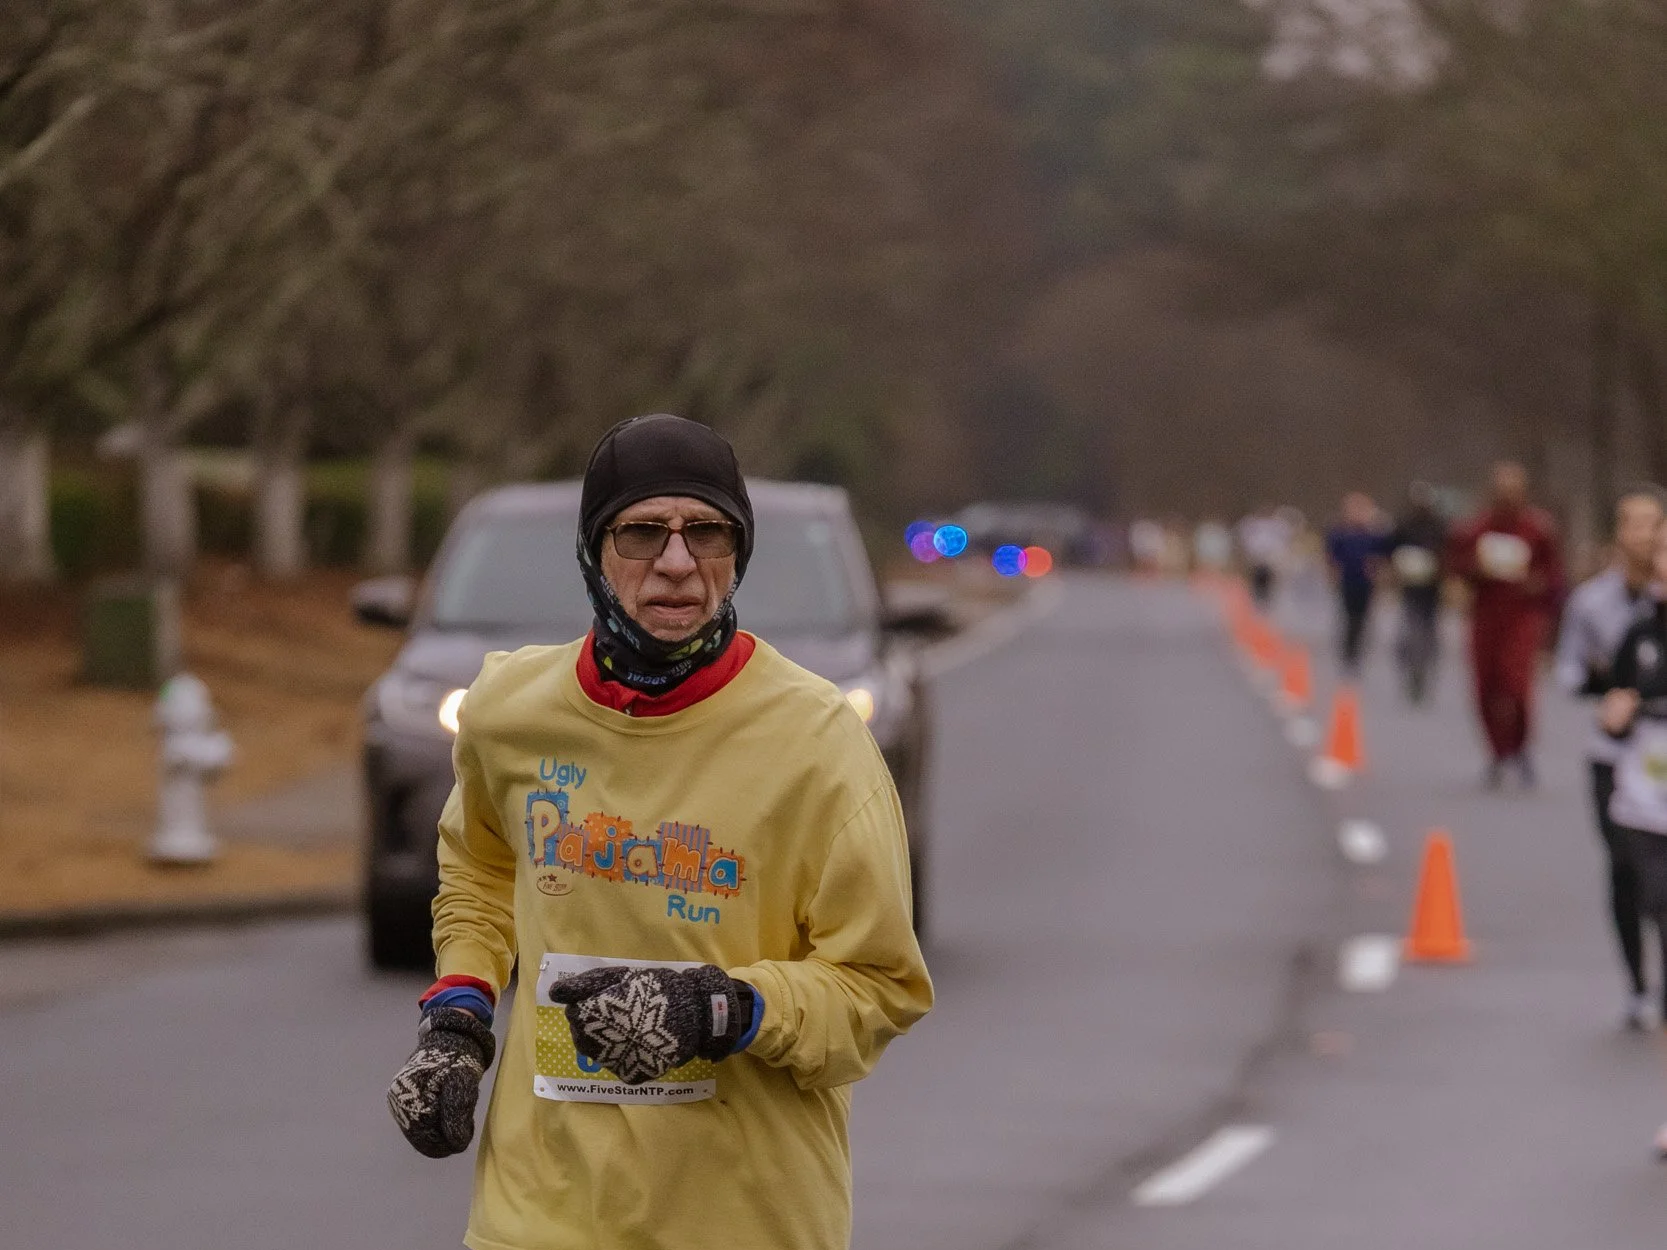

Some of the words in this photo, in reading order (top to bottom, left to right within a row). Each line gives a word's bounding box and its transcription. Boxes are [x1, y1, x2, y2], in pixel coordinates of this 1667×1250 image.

[539, 756, 587, 789] Ugly
[529, 799, 740, 891] Pajama
[667, 894, 720, 924] Run
[557, 1084, 694, 1096] www.FiveStarNTP.com
